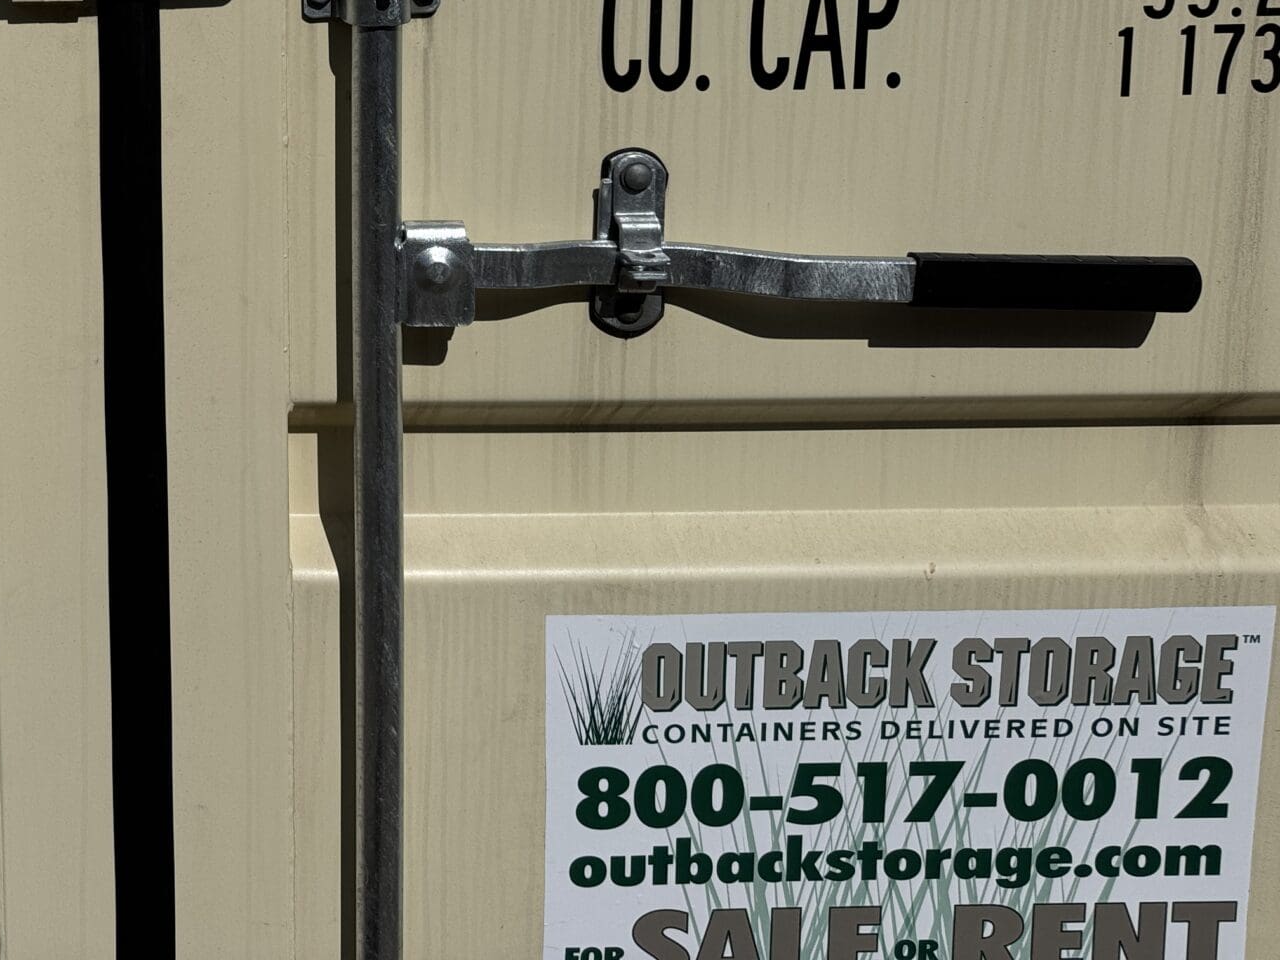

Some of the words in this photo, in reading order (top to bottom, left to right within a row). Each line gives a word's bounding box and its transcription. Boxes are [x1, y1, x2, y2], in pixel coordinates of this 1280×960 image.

[1119, 27, 1133, 96] 1
[1181, 23, 1280, 95] 173
[641, 638, 937, 712] OUTBACK
[950, 634, 1240, 708] STORAGE
[642, 721, 864, 744] CONTAINERS
[881, 718, 1073, 741] DELIVERED
[1092, 717, 1140, 738] ON
[1158, 716, 1232, 737] SITE
[575, 756, 1234, 831] 800-517-0012
[568, 835, 1223, 889] outbackstorage.com
[631, 905, 883, 960] SALE
[894, 940, 939, 960] OR
[952, 901, 1239, 960] RENT
